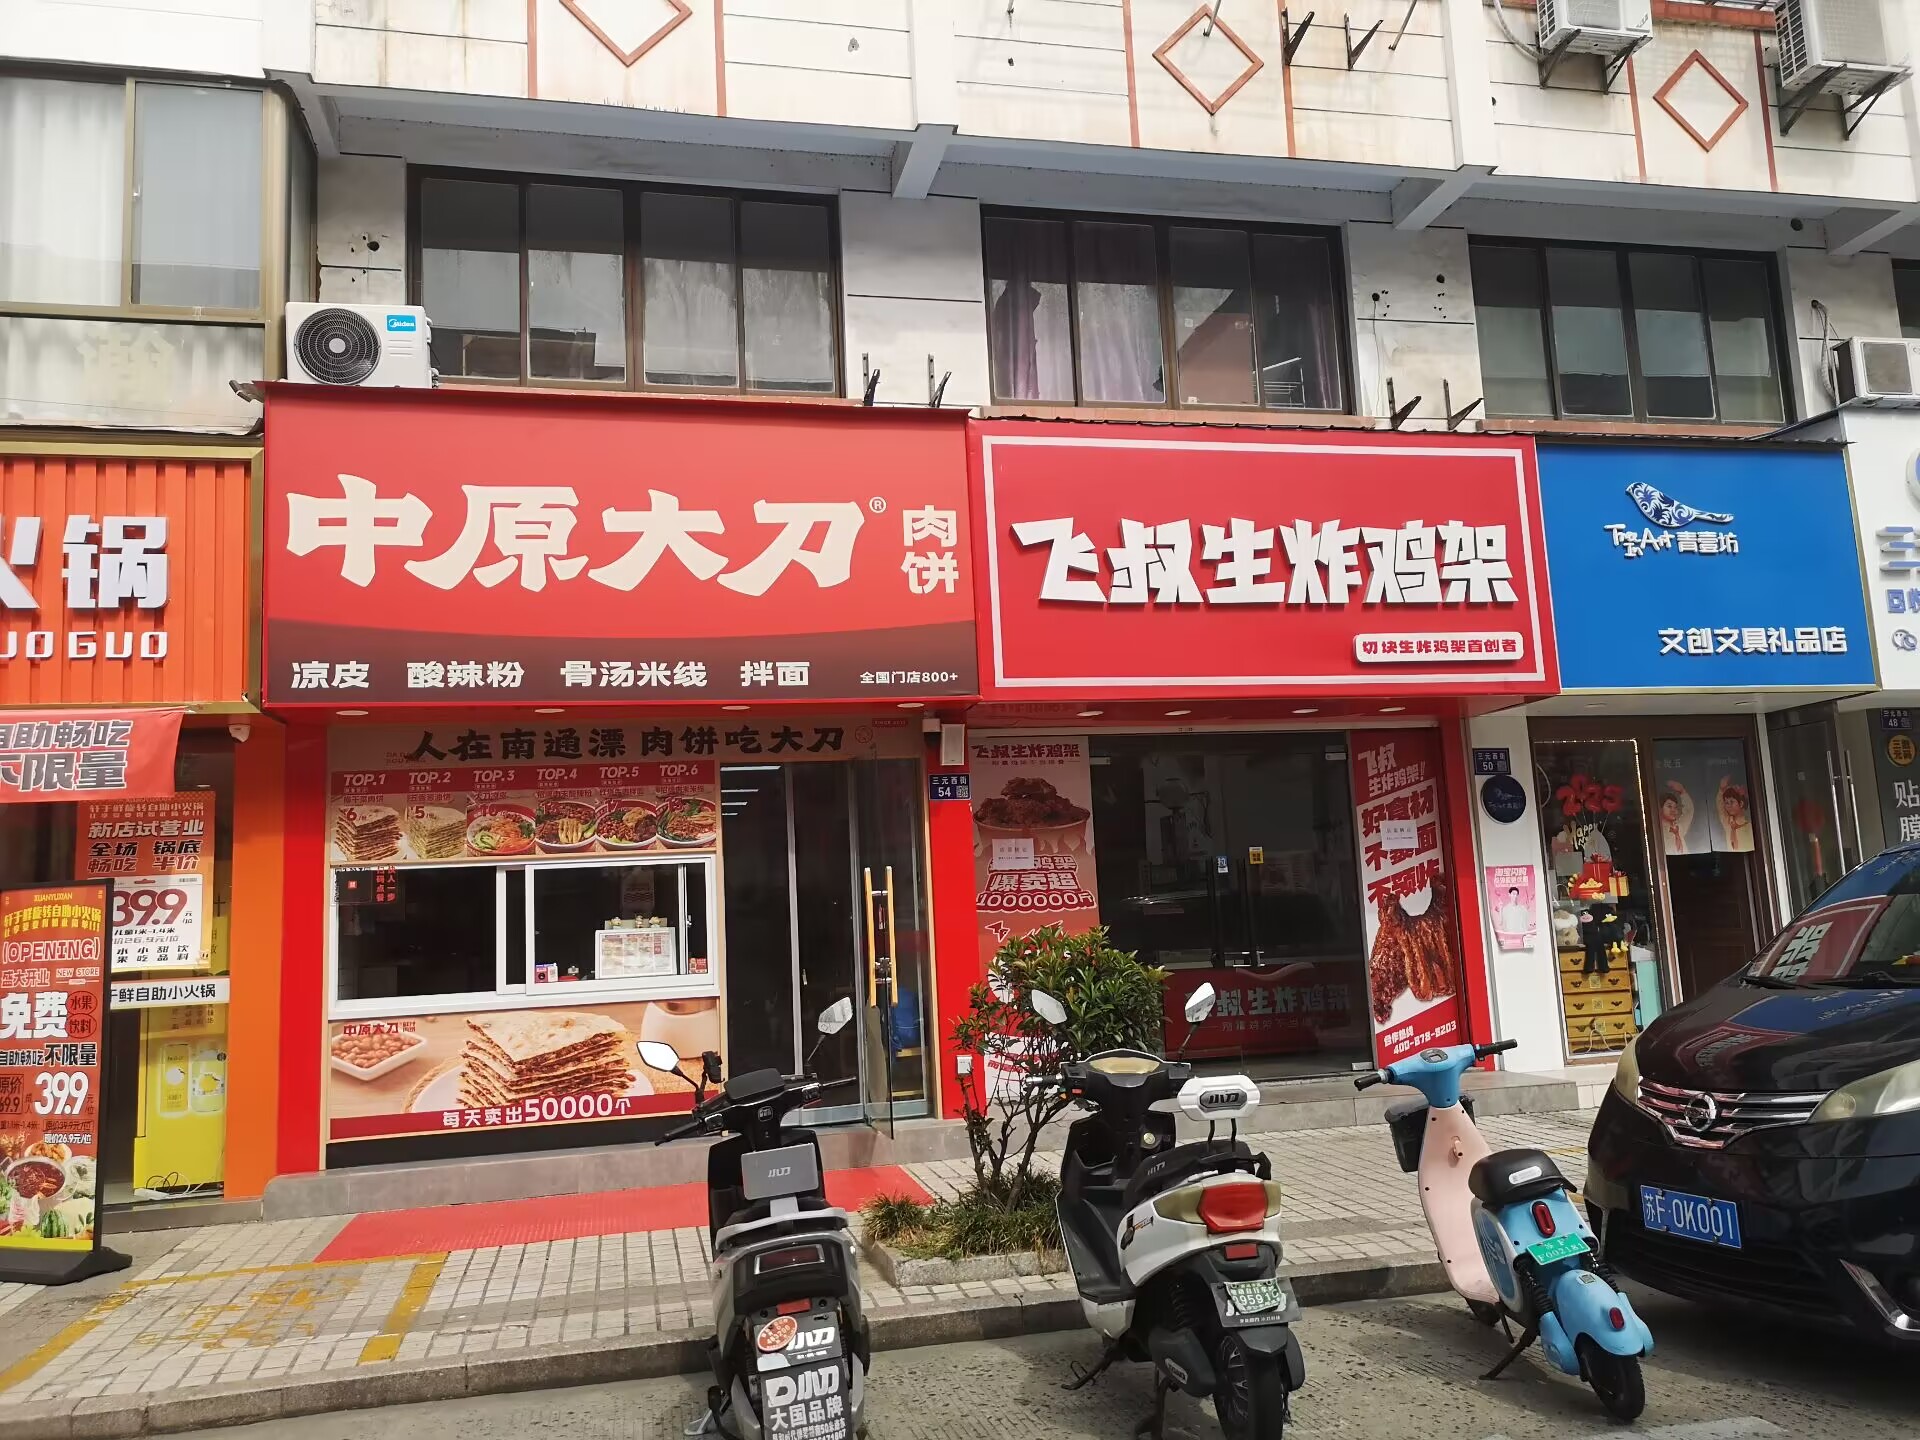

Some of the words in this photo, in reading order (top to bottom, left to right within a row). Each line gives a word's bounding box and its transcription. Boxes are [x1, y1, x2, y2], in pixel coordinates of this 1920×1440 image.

[286, 473, 865, 597] 中原大刀
[1676, 531, 1739, 554] 青壹坊
[901, 505, 960, 594] 肉饼
[1010, 517, 1519, 604] 飞叔生炸鸡架
[1362, 638, 1517, 655] 切块生炸鸡架首创者
[1658, 626, 1847, 655] 文创文具礼品店
[290, 660, 370, 690] 凉皮
[407, 660, 525, 688] 酸辣粉
[560, 660, 708, 688] 骨汤米线
[740, 660, 810, 687] 拌面
[860, 671, 959, 685] 全国门店800+
[0, 720, 133, 749] 助畅吃
[410, 728, 626, 761] 人在南通漂
[640, 726, 845, 757] 肉饼吃大刀
[1357, 742, 1397, 777] 飞叔
[1482, 761, 1494, 771] 50
[343, 773, 387, 787] TOP.1
[408, 771, 452, 785] TOP.2
[473, 769, 516, 783] TOP.3
[537, 767, 578, 781] TOP.4
[599, 766, 640, 779] TOP.5
[659, 764, 699, 777] TOP.6
[931, 776, 967, 786] 三元西街
[938, 786, 952, 798] 54
[1361, 785, 1434, 838] 好食材
[88, 819, 205, 839] 新店试营业
[89, 841, 139, 857] 全场
[153, 840, 202, 855] 锅底
[87, 857, 137, 873] 畅吃
[152, 855, 200, 871] 半价
[989, 873, 1078, 892] 爆卖超
[113, 887, 188, 928] 39.9
[1, 968, 50, 988] 盛大开业
[56, 968, 75, 977] NEW
[77, 967, 99, 976] STORE
[70, 995, 93, 1010] 水果
[1185, 984, 1350, 1017] 叔生炸鸡架
[0, 991, 69, 1039] 免费
[68, 1018, 93, 1035] 饮料
[343, 1022, 400, 1036] 中原大刀
[44, 1043, 97, 1067] 不限量
[34, 1071, 89, 1115] 39.9
[442, 1093, 632, 1128] 每天卖出50000个
[770, 1395, 844, 1431] 大国品牌
